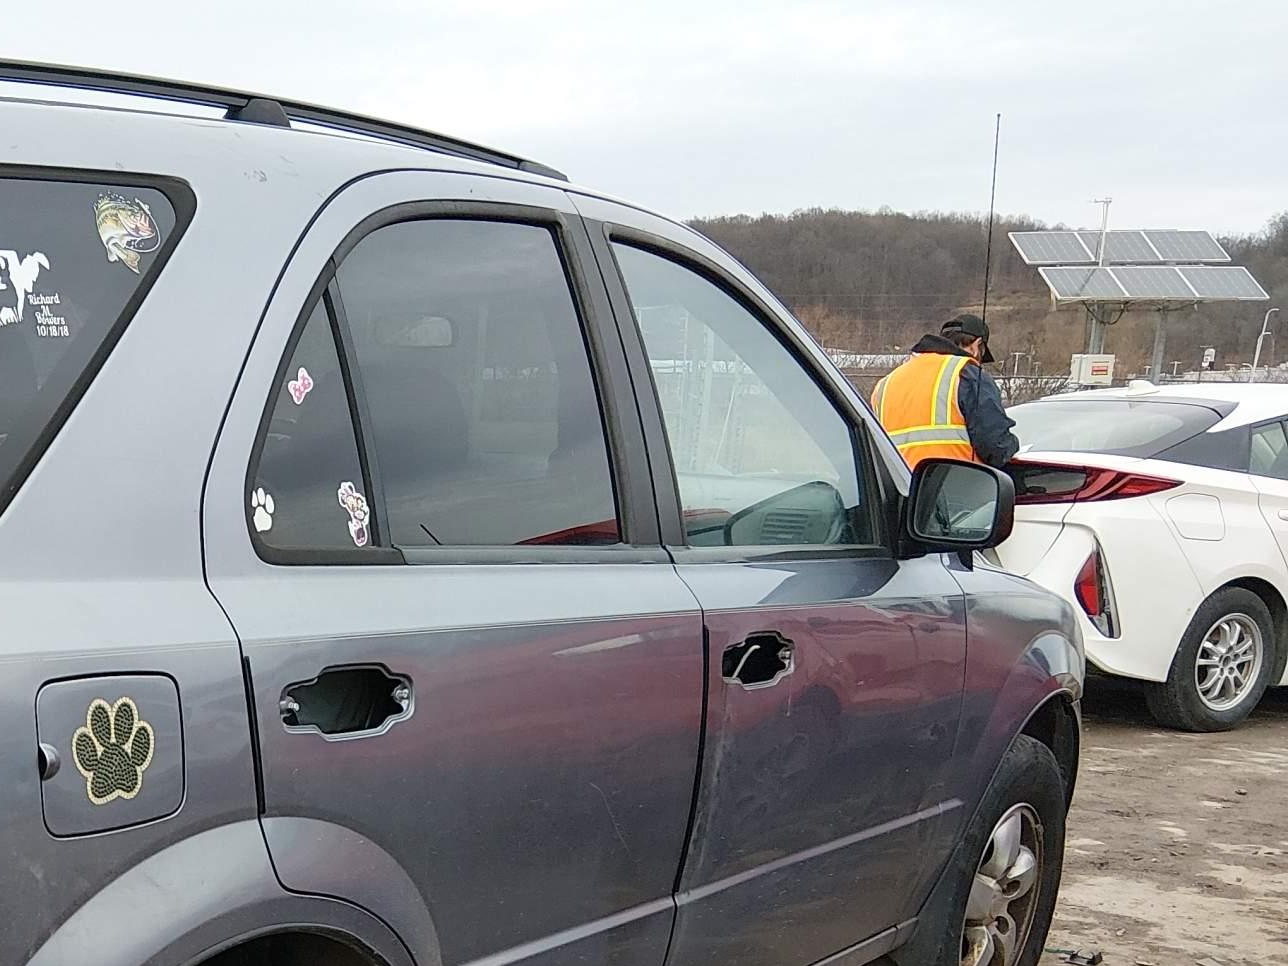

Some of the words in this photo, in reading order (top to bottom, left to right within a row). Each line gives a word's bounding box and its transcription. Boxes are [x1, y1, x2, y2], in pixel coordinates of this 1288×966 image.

[27, 293, 61, 305] Richard
[35, 311, 66, 325] Bowers
[36, 325, 70, 337] 10/18/18
